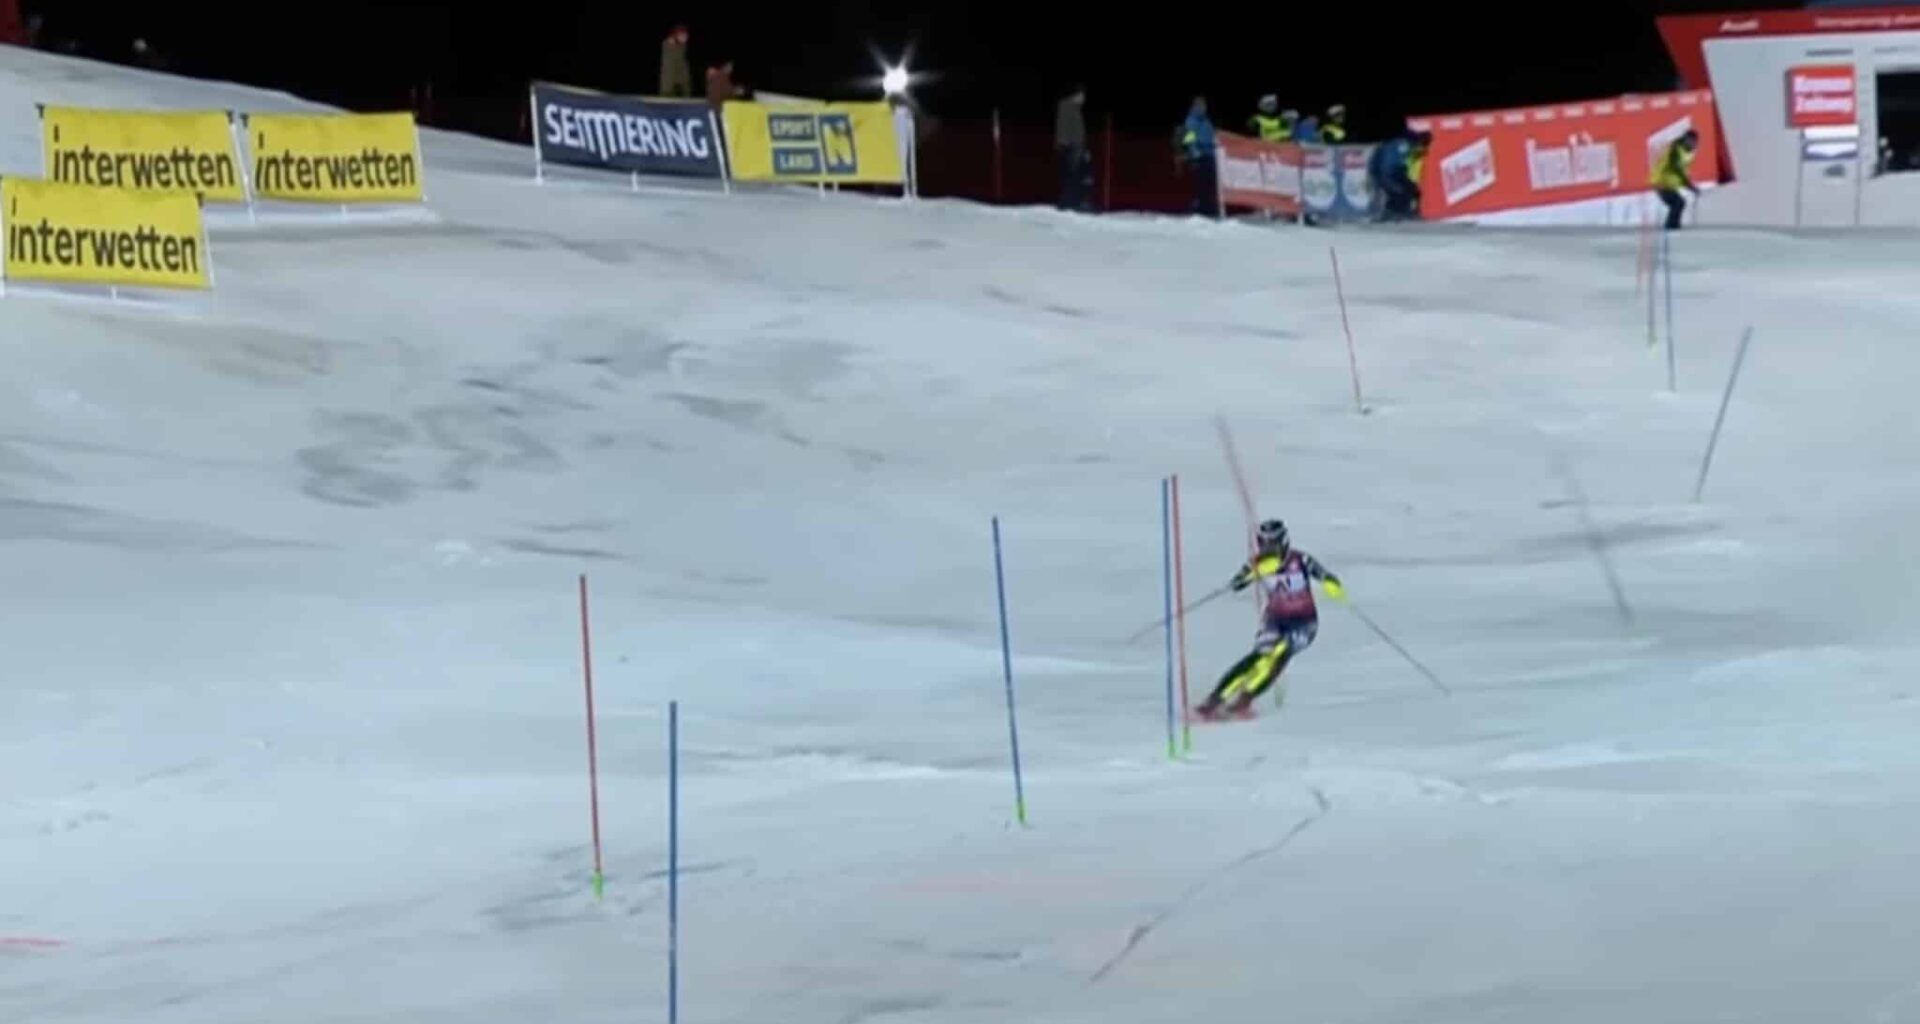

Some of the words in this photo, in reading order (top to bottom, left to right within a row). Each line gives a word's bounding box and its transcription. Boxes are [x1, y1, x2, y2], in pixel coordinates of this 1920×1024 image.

[53, 124, 235, 188] interwetten
[255, 131, 415, 190] interwetten
[9, 196, 199, 273] interwetten
